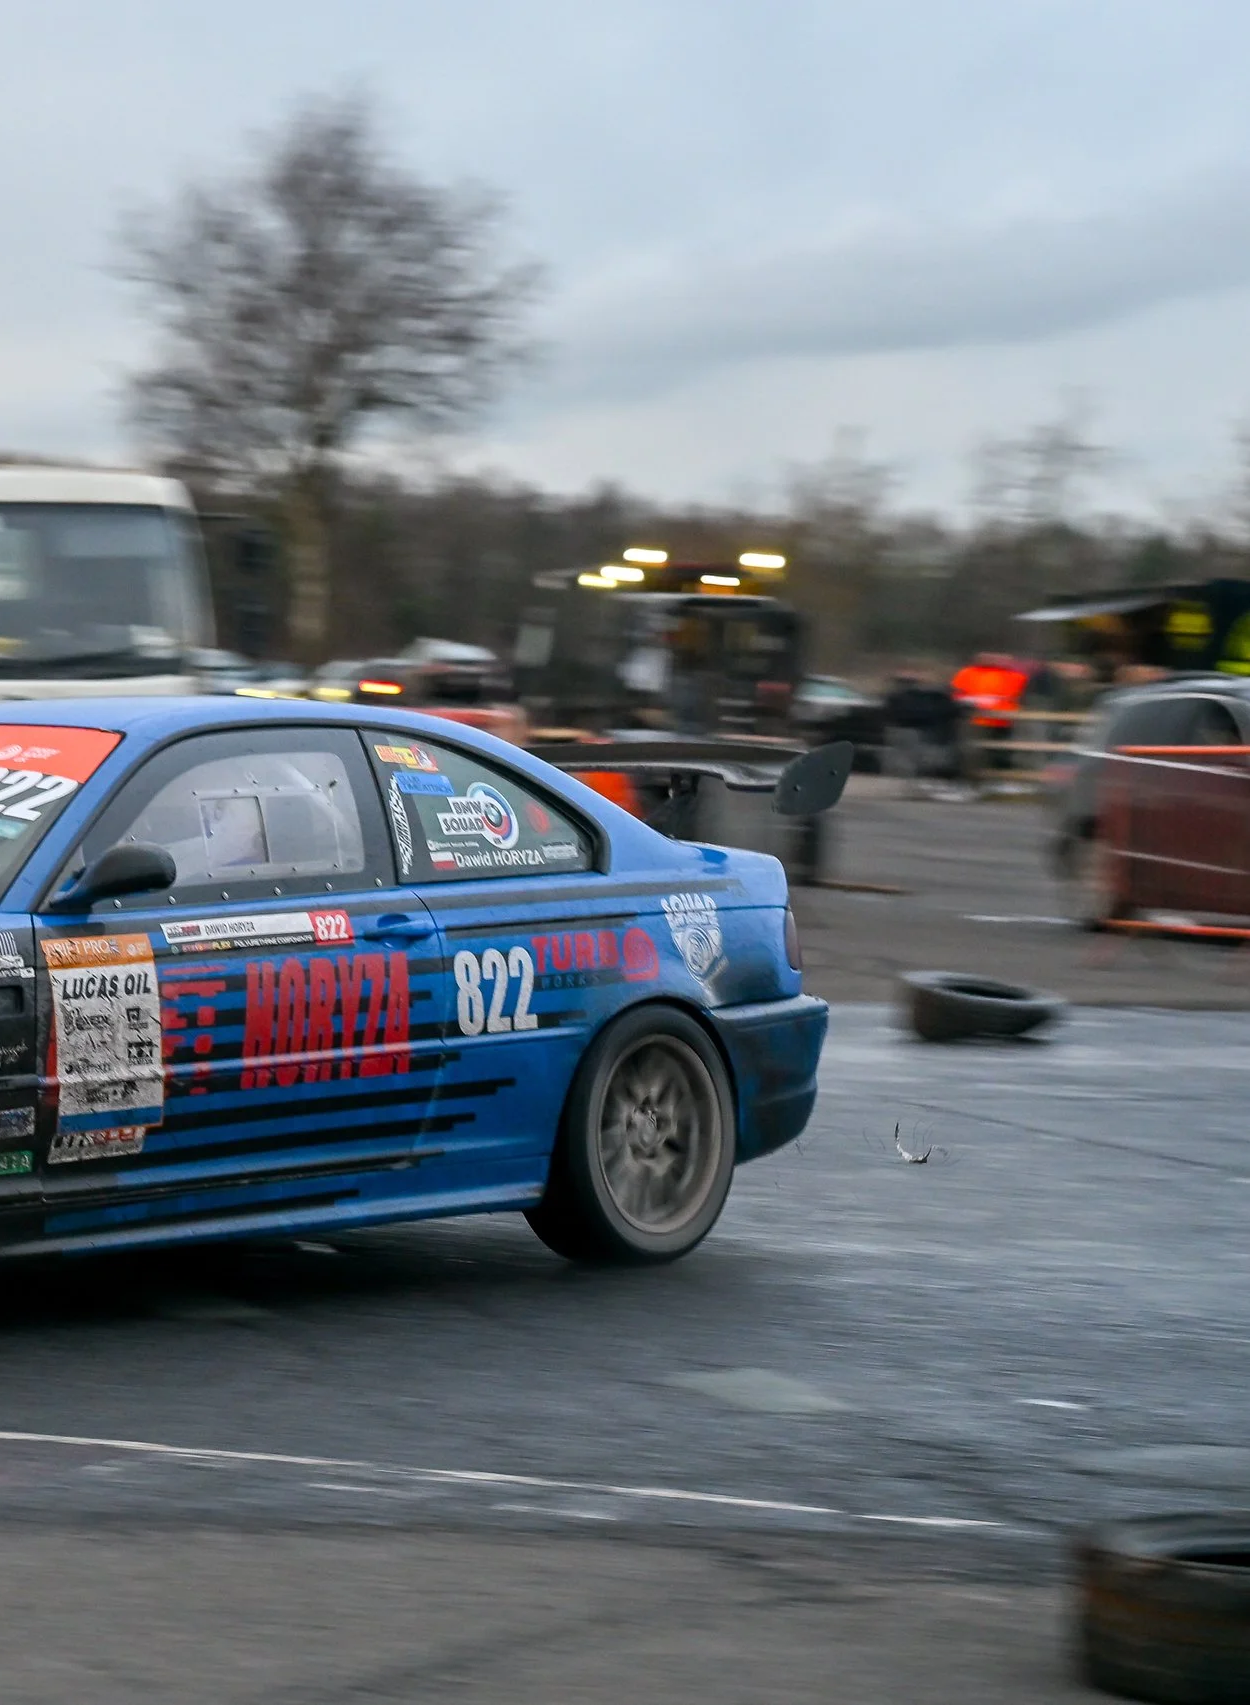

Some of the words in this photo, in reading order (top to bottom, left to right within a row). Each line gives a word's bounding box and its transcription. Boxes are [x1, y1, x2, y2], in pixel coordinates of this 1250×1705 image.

[452, 800, 483, 815] BMW
[441, 817, 486, 833] SQUAD
[453, 850, 493, 868] Dawid
[493, 849, 546, 866] HORYZA
[315, 913, 350, 942] 822
[46, 940, 81, 958] DRIFT
[82, 939, 111, 955] PRO
[62, 973, 120, 1000] LUCAS
[124, 970, 152, 996] OIL
[453, 945, 538, 1037] 822
[239, 951, 410, 1090] HORYZA
